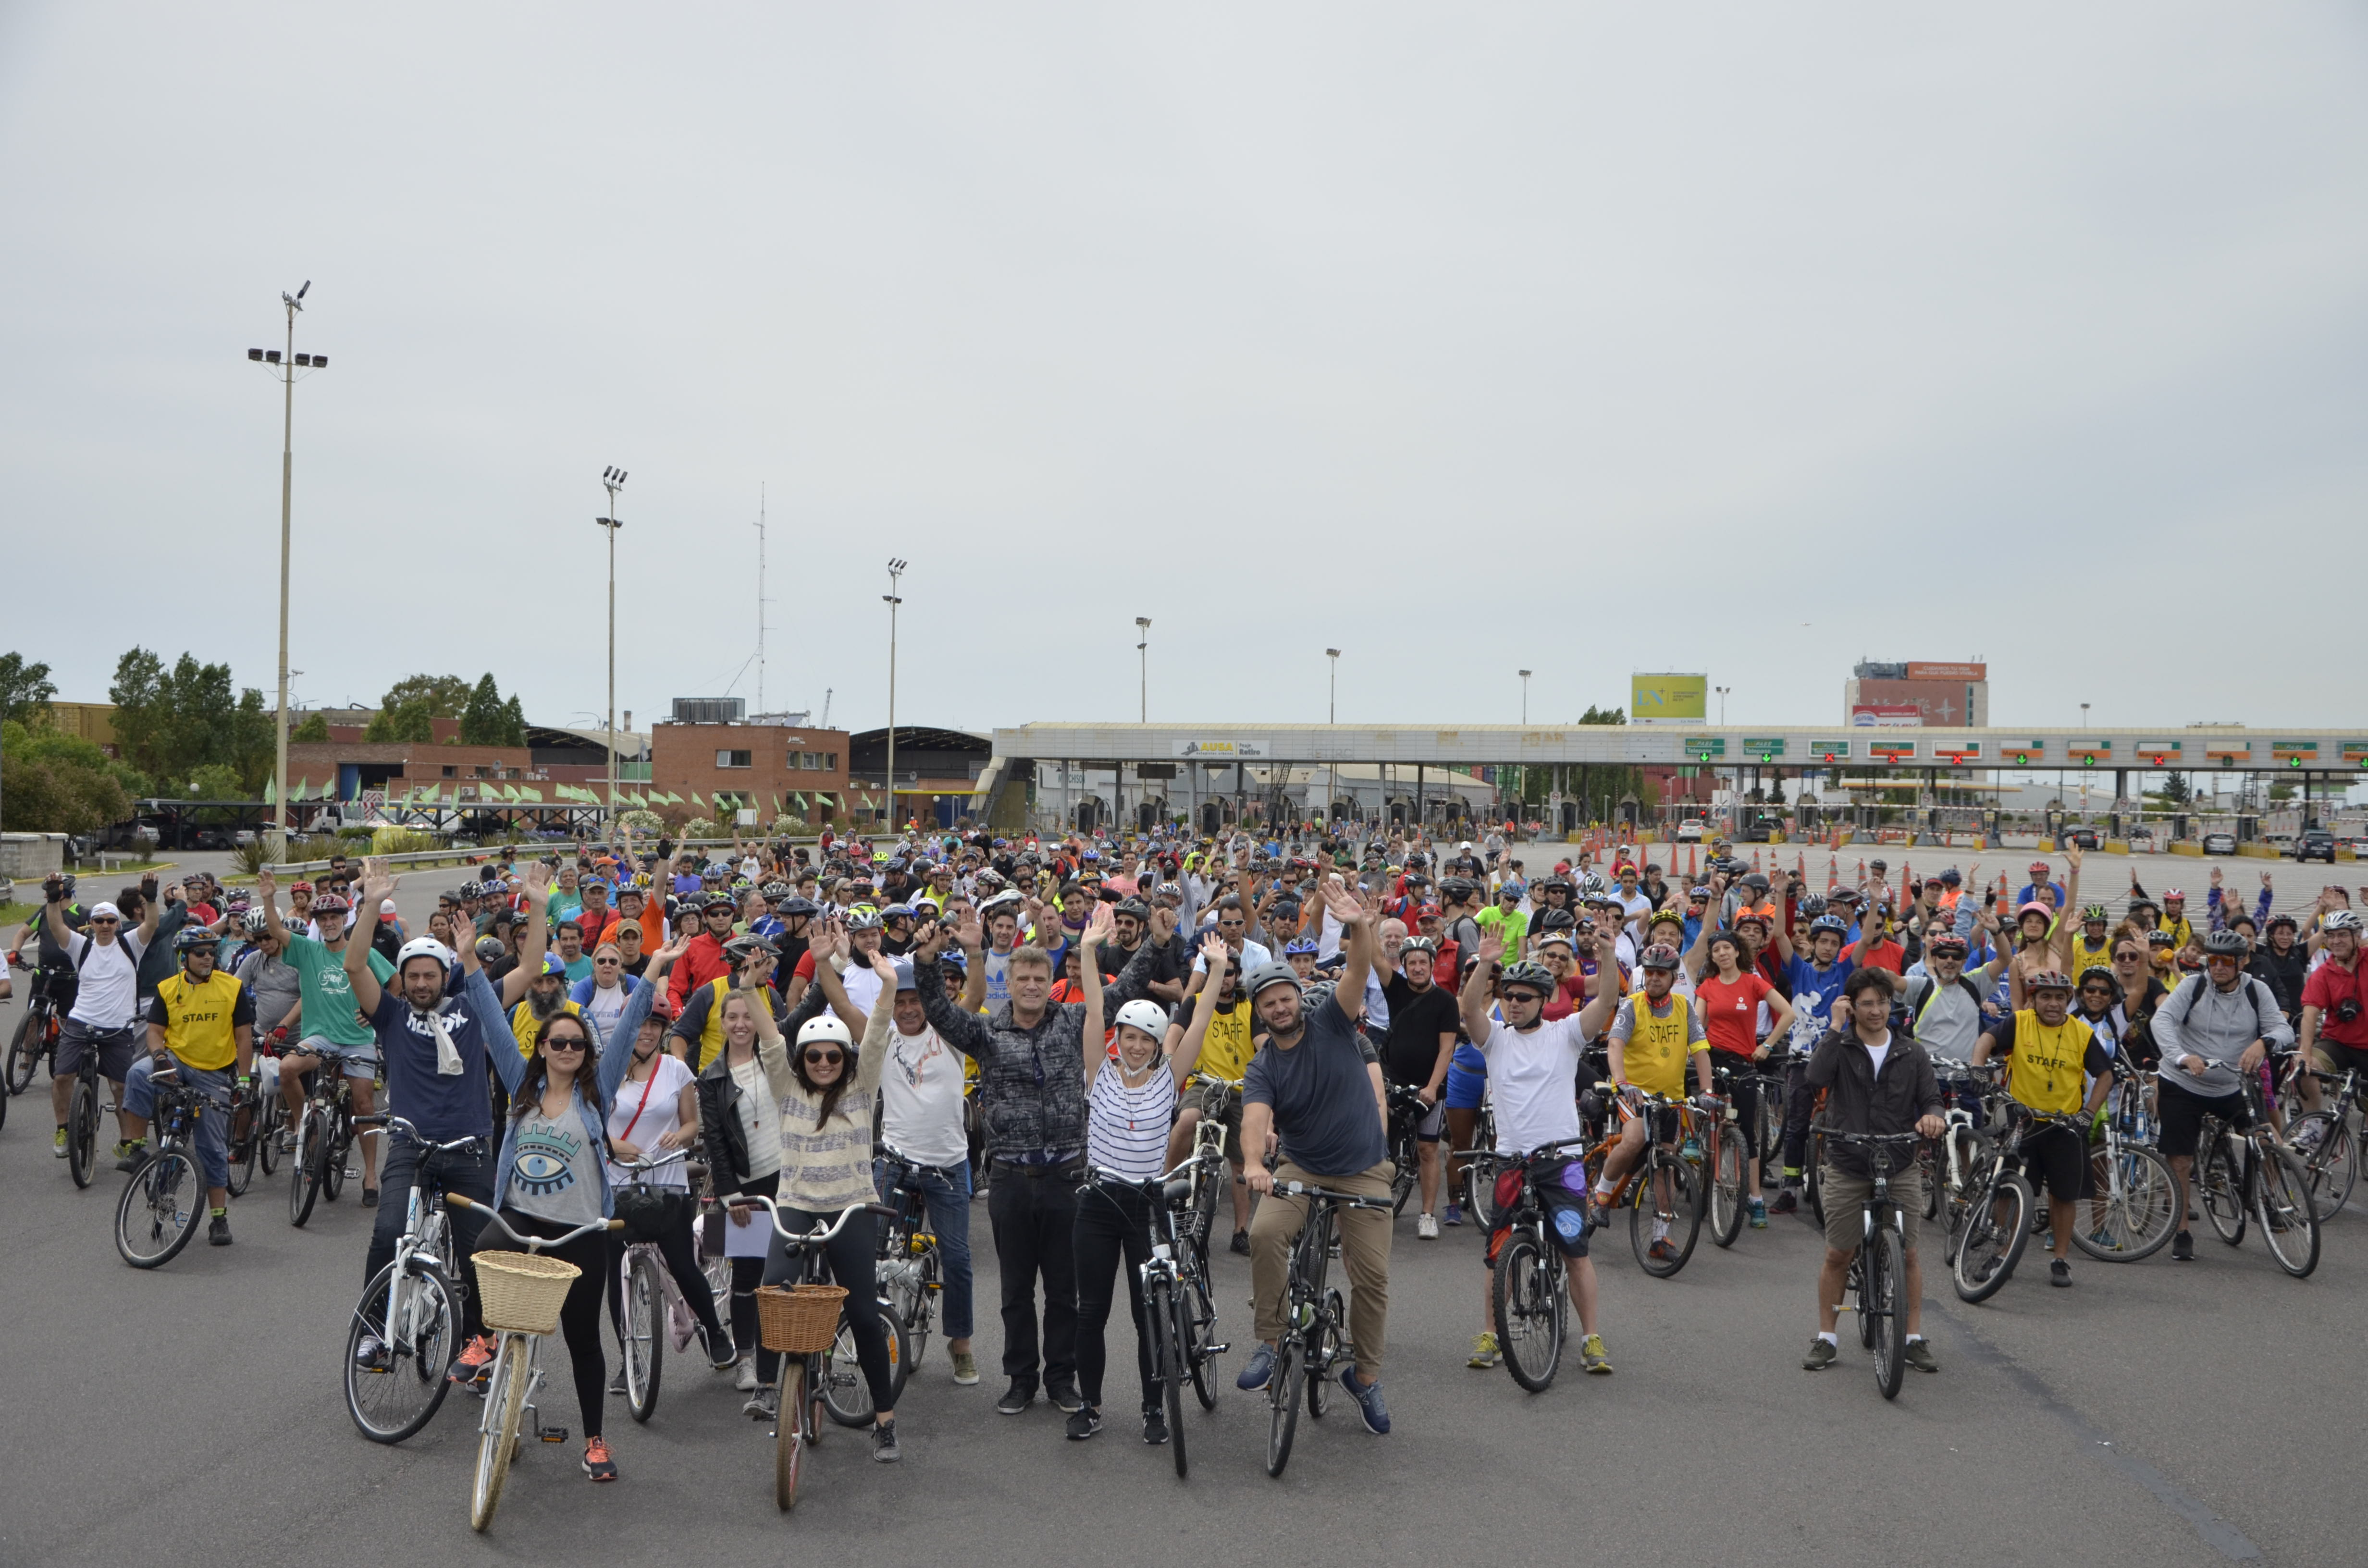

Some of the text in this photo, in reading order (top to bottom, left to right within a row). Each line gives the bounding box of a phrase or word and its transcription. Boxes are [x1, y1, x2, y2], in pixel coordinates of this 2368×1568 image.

[1200, 742, 1233, 751] AUSA
[183, 1012, 218, 1023] STAFF
[1212, 1020, 1243, 1041] STAFF
[1649, 1024, 1679, 1043] STAFF
[2027, 1054, 2066, 1069] STAFF
